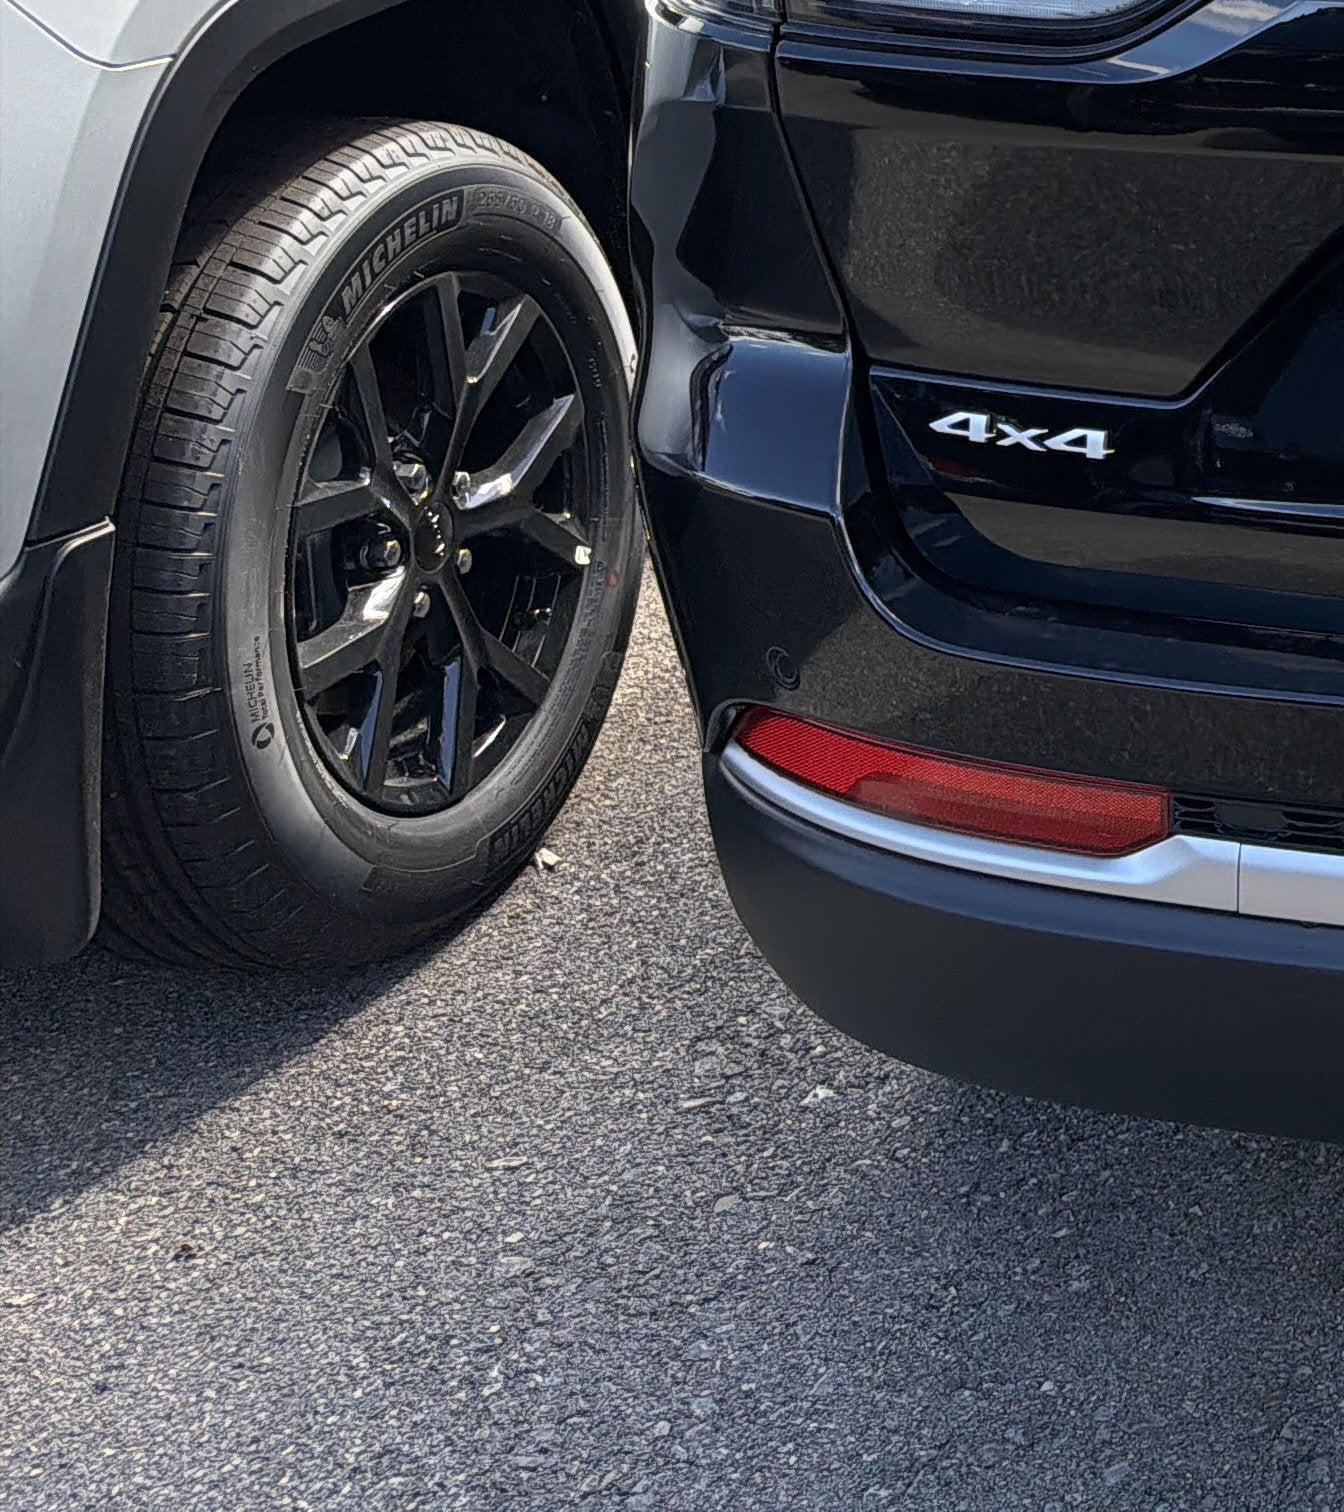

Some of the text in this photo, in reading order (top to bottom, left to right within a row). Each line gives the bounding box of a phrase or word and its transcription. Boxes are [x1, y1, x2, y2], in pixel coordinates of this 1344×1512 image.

[341, 196, 459, 315] MICHELIN
[929, 411, 1115, 460] 4x4
[243, 662, 261, 723] MICHELIN
[261, 698, 269, 721] Total
